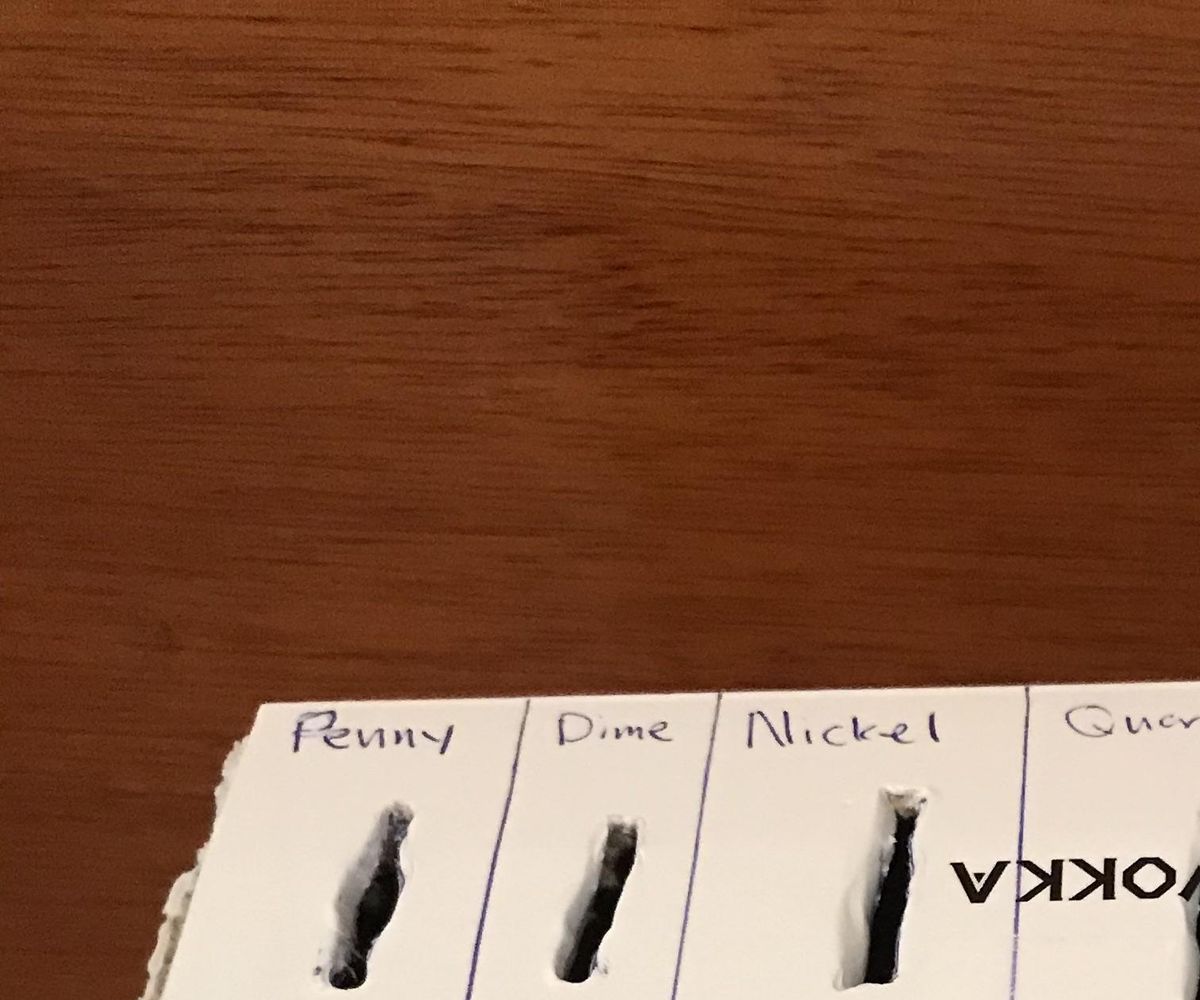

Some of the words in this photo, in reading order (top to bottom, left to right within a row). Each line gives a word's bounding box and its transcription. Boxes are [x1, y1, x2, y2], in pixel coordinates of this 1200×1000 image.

[291, 709, 455, 755] Penny
[557, 711, 673, 746] Dime
[746, 709, 941, 750] Nickel
